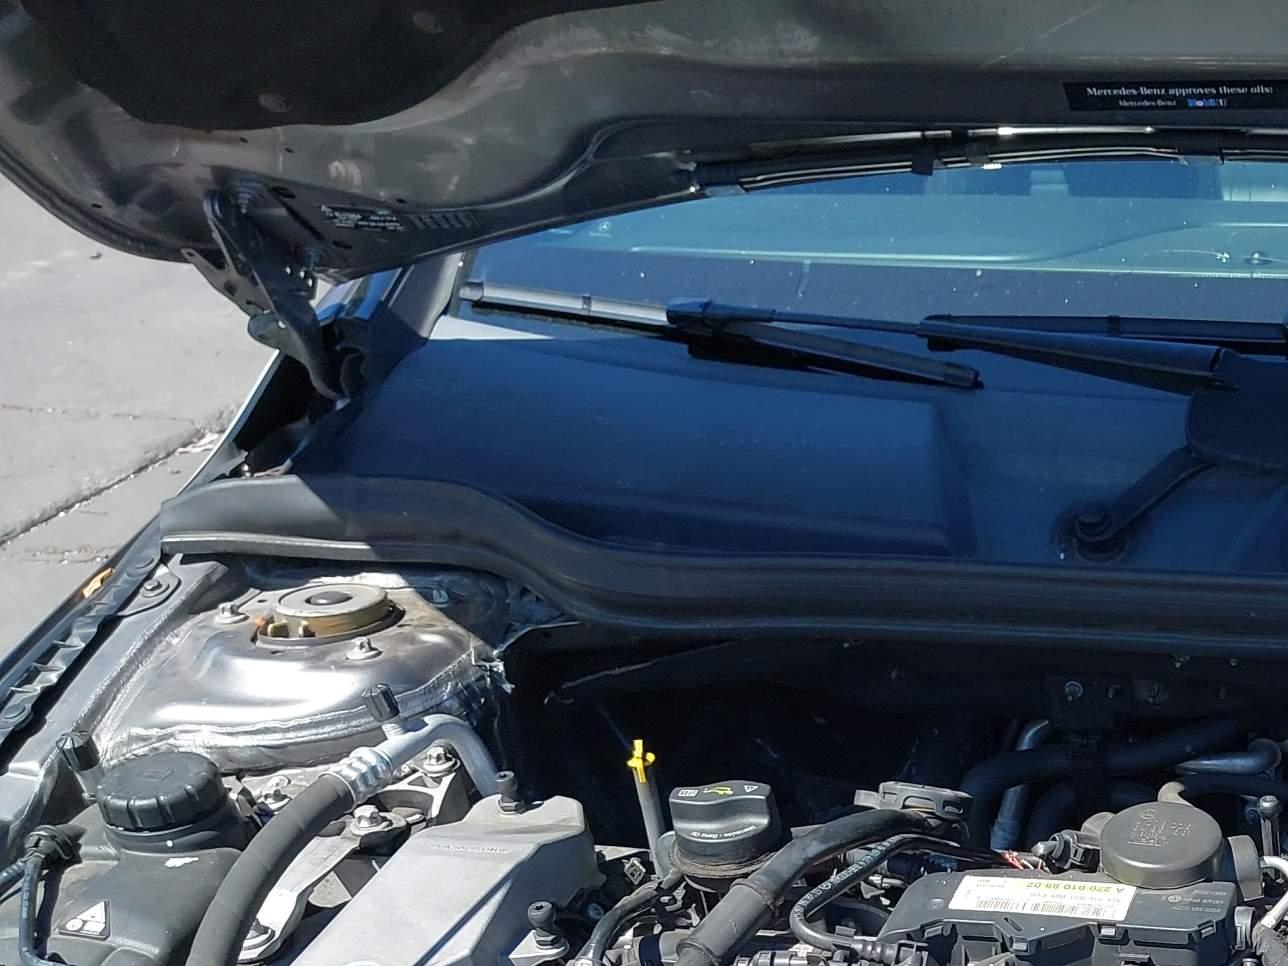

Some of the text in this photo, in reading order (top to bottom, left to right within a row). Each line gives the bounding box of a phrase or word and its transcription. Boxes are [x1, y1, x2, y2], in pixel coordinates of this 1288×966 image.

[1086, 86, 1165, 96] Mercedes-Benz
[1168, 86, 1216, 96] approves
[1219, 85, 1248, 95] these
